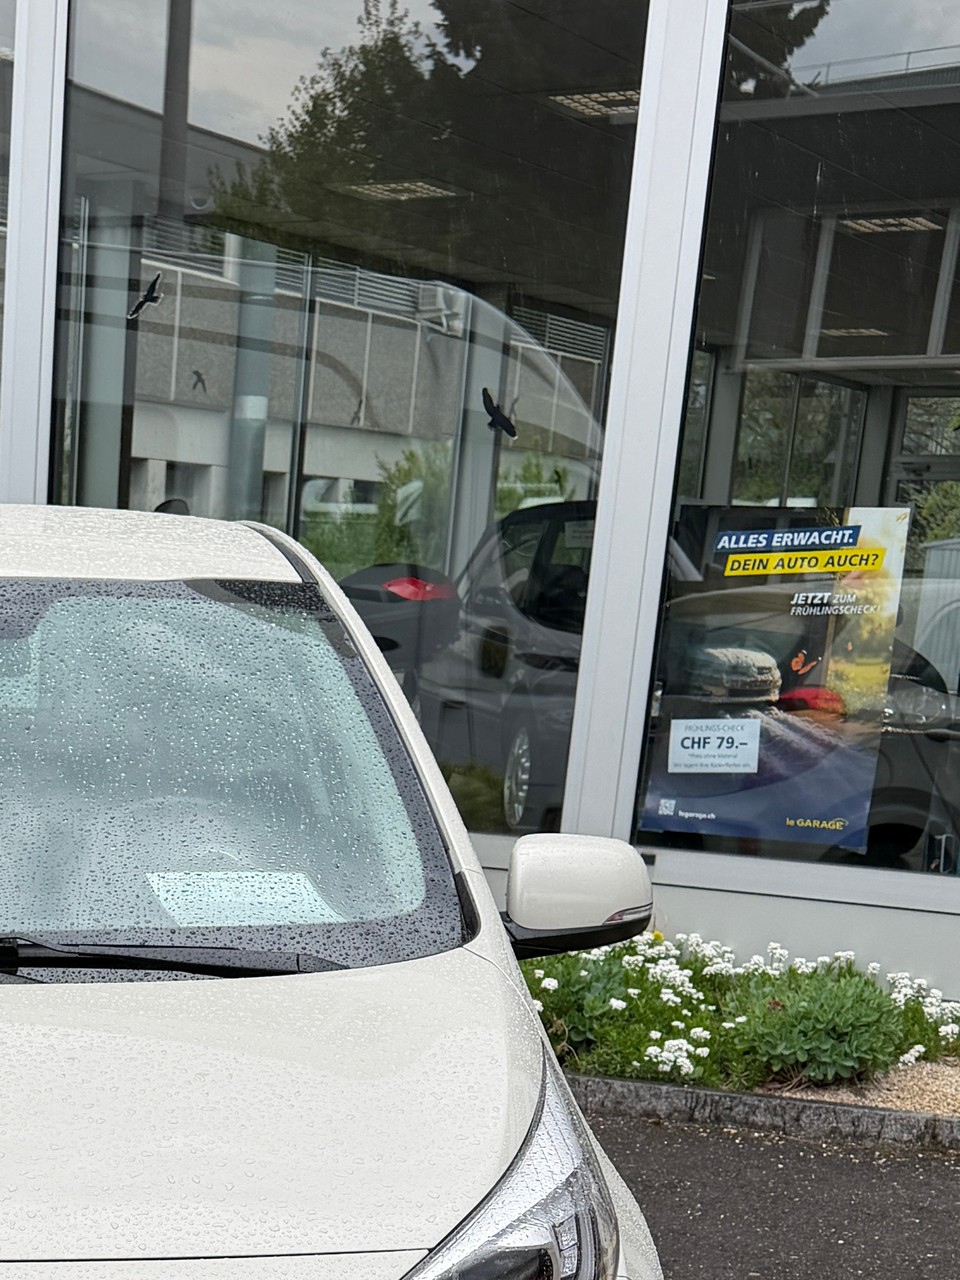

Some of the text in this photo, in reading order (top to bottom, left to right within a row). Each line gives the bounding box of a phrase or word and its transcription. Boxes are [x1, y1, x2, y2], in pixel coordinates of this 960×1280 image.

[717, 529, 853, 549] ALLES ERWACHT.
[729, 553, 879, 572] DEIN AUTO AUCH?
[790, 592, 857, 605] JETZT ZUM
[681, 737, 711, 749] CHF
[796, 818, 844, 830] GARAGE
